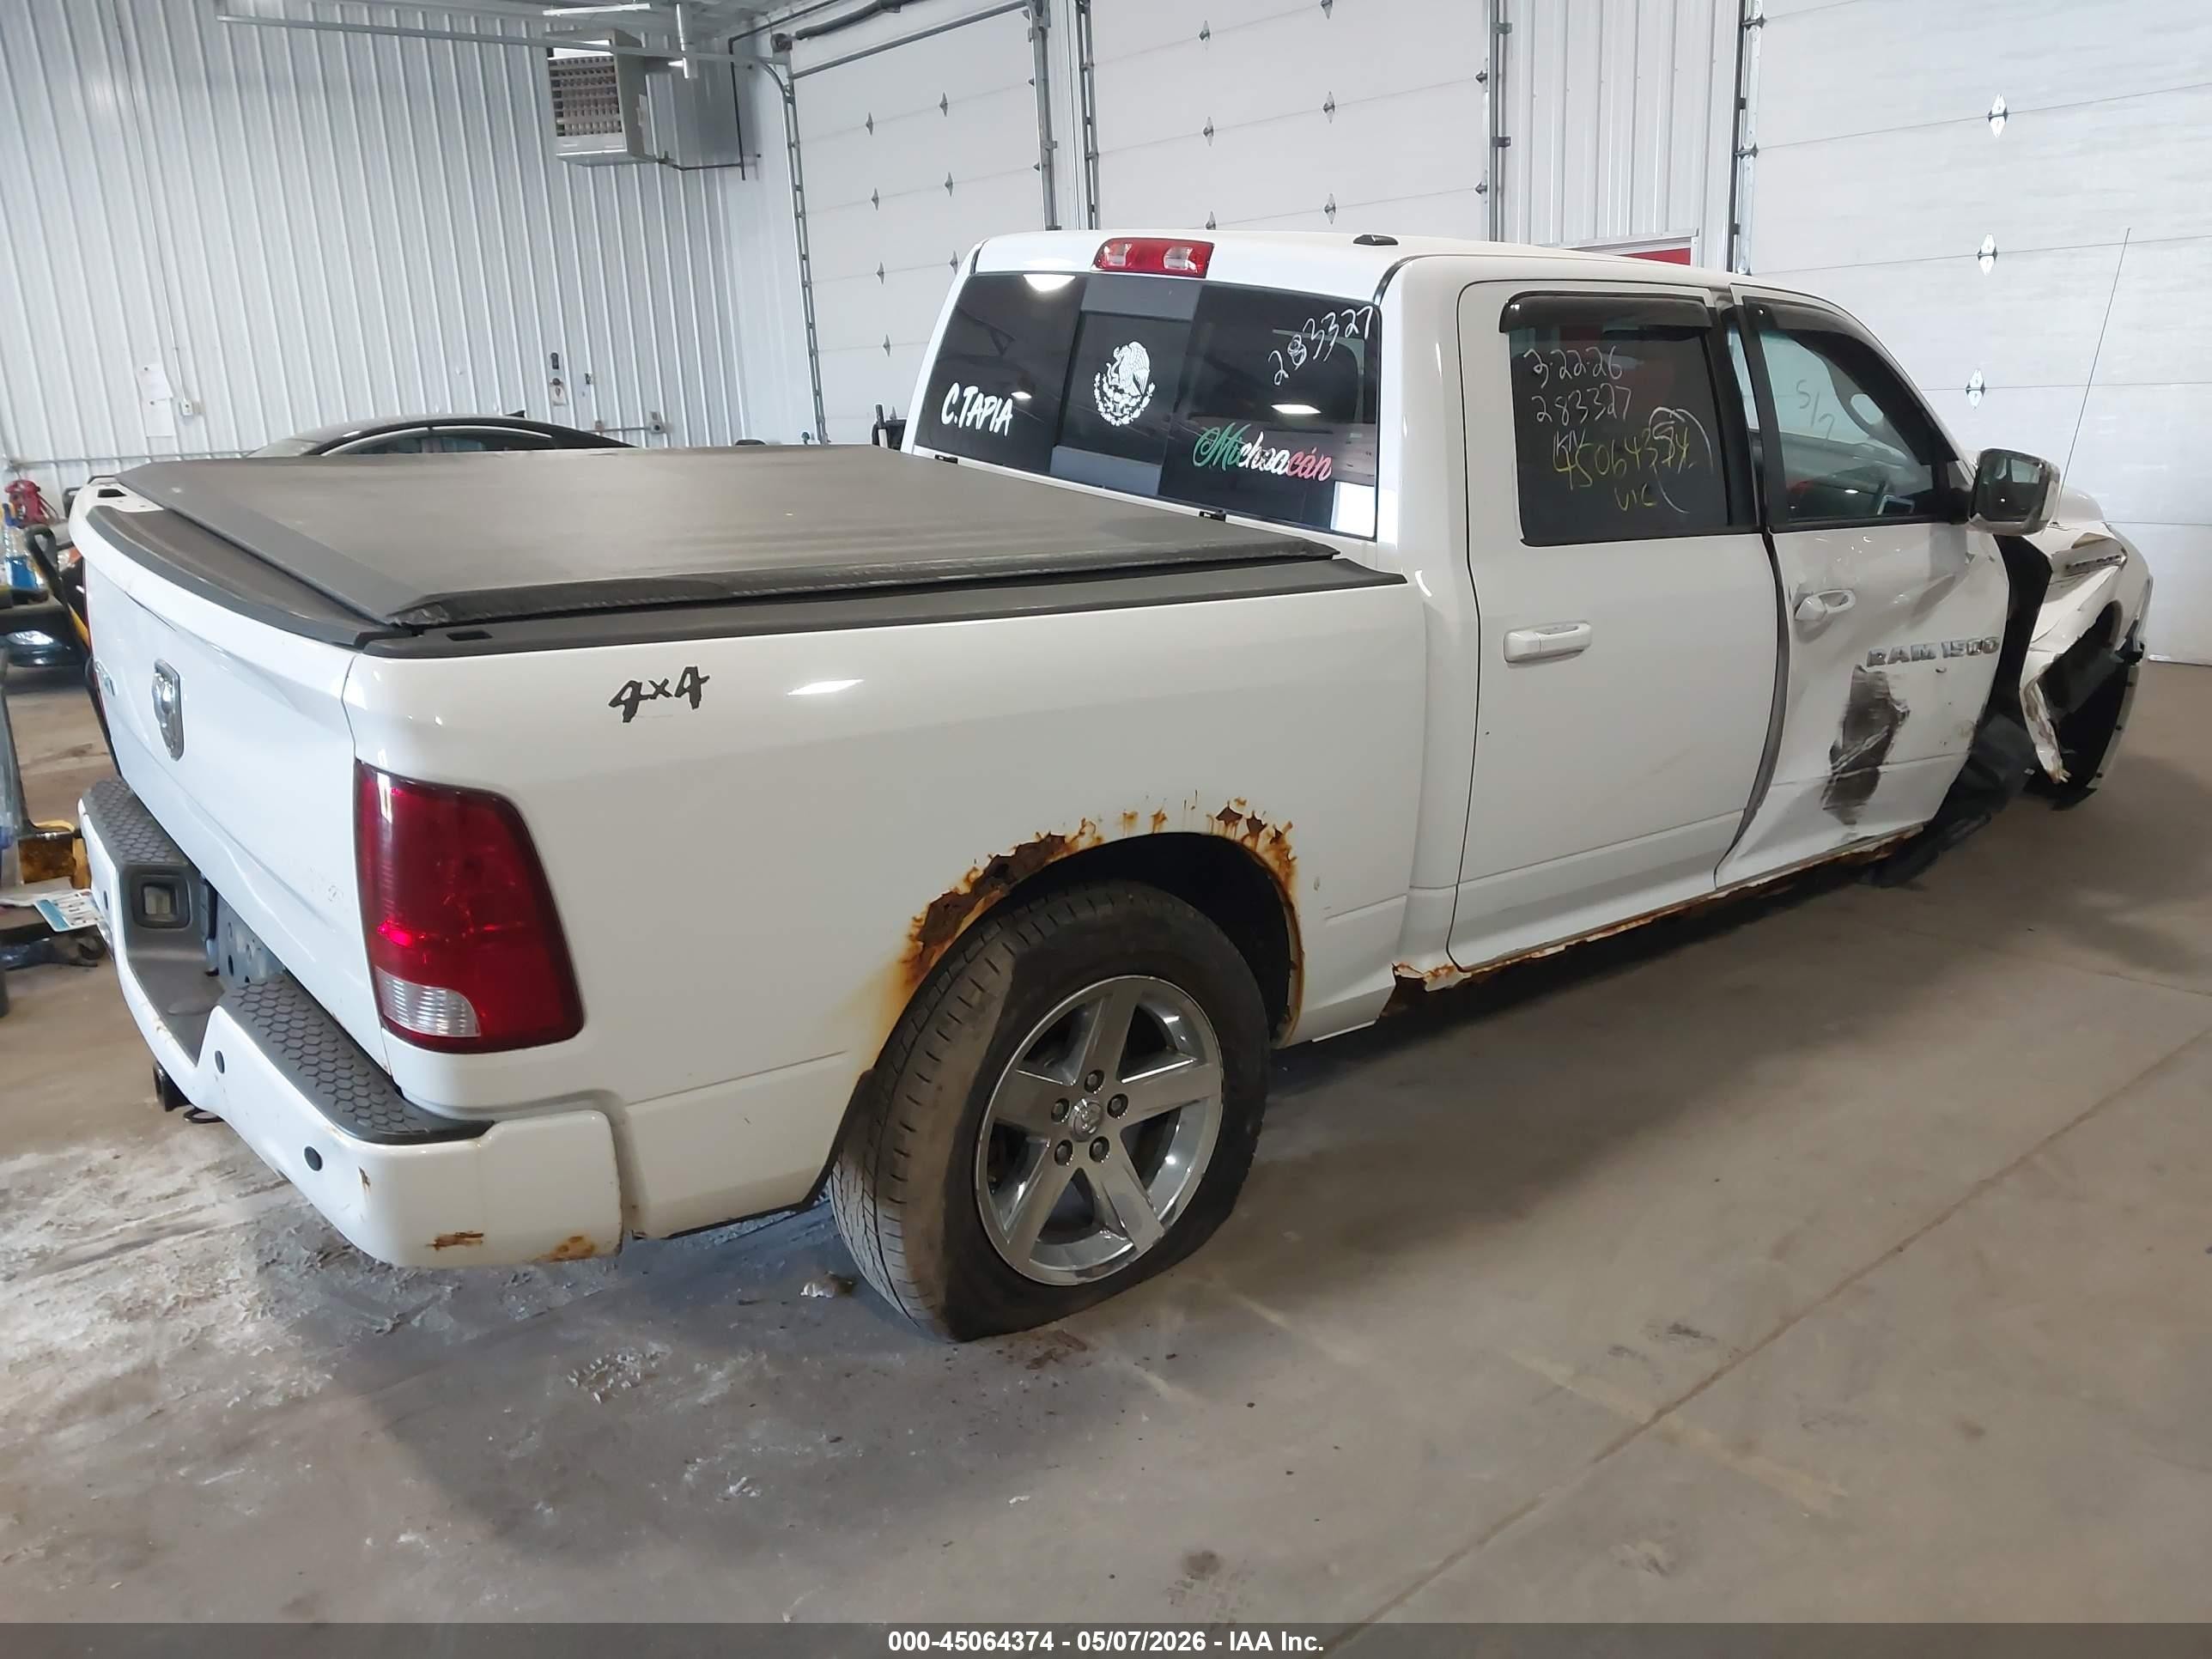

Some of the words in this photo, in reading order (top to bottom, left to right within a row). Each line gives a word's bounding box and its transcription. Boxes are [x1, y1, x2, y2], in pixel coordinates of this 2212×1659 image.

[1531, 383, 1632, 427] 283327
[1192, 422, 1333, 482] Michoacán
[1867, 643, 1936, 667] RAM
[1941, 636, 1999, 659] 1500
[608, 665, 710, 723] 4x4
